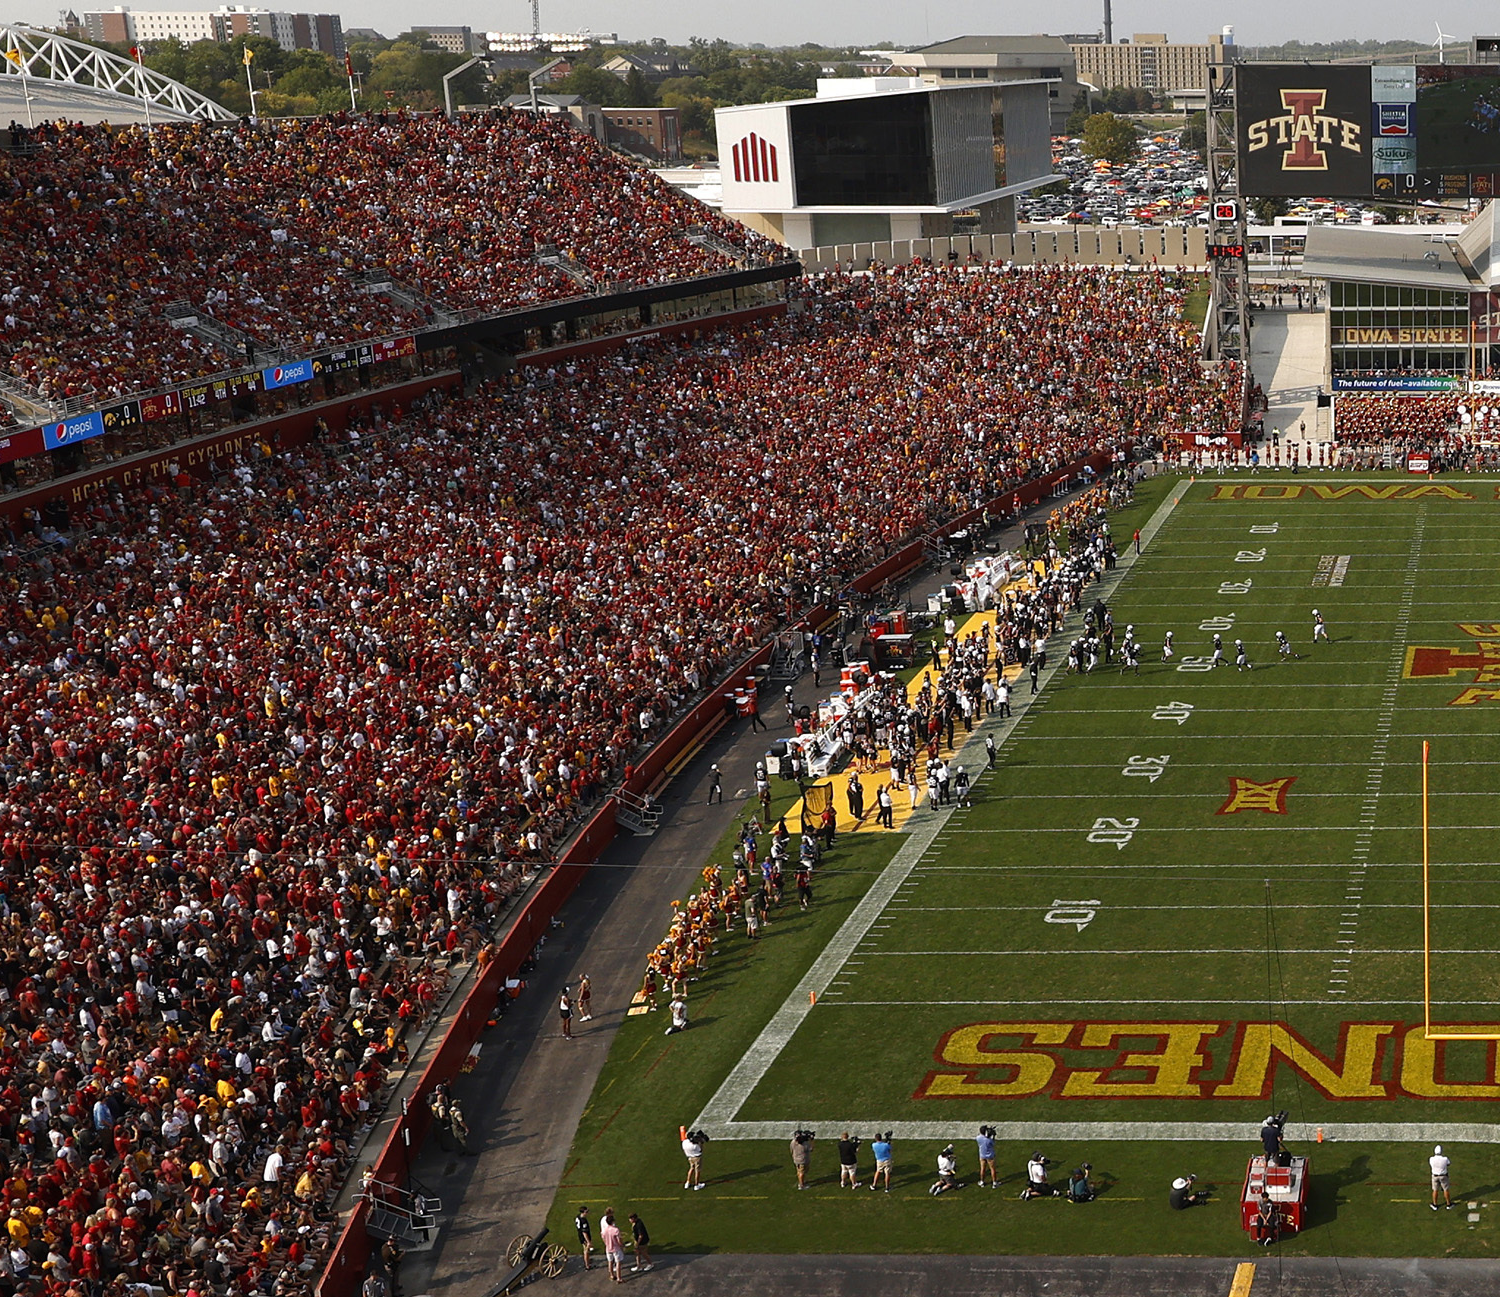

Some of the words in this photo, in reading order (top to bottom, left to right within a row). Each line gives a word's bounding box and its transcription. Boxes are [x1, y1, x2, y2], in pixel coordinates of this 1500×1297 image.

[1248, 114, 1361, 153] STATE
[1376, 147, 1412, 160] Sukup
[1405, 174, 1415, 188] 0
[1217, 206, 1233, 217] 26
[1339, 328, 1394, 343] IOWA
[1400, 328, 1463, 343] STATE
[284, 365, 304, 381] pepsi
[247, 381, 257, 391] 44
[1338, 379, 1352, 387] The
[1353, 379, 1374, 387] future
[1375, 379, 1387, 387] of
[165, 395, 172, 407] 0
[215, 388, 227, 400] 4TH
[123, 406, 130, 418] 0
[69, 417, 93, 439] pepsi
[1207, 484, 1477, 500] IOWA
[1234, 549, 1267, 562] 20
[1217, 581, 1252, 594] 30
[1198, 615, 1236, 631] 40
[1151, 701, 1194, 720] 40
[1121, 754, 1171, 777] 30
[1085, 817, 1140, 843] 20
[1043, 899, 1101, 924] 10
